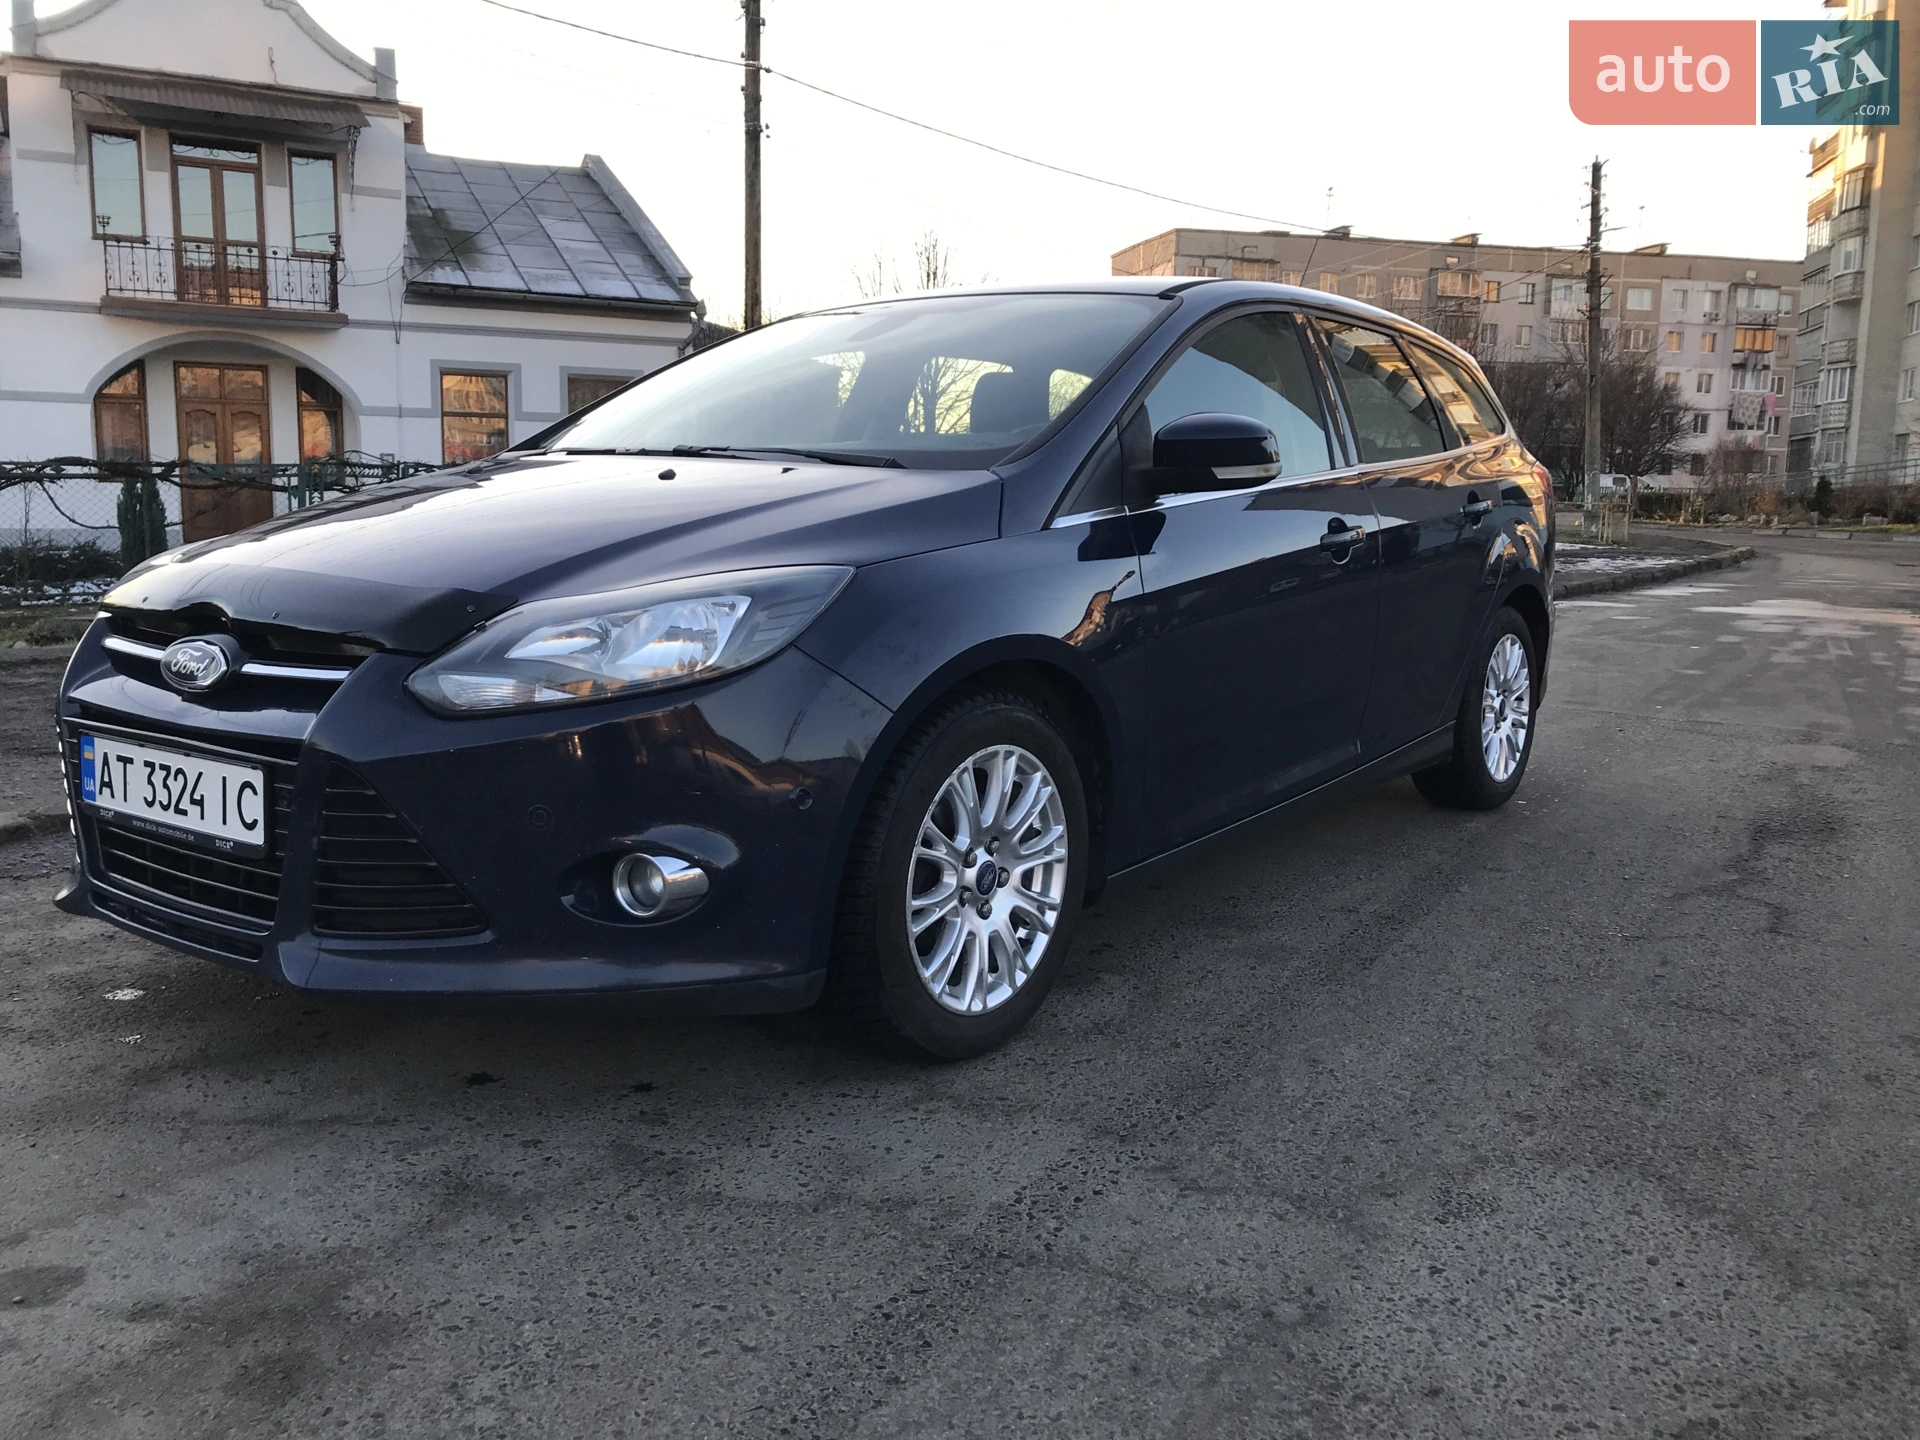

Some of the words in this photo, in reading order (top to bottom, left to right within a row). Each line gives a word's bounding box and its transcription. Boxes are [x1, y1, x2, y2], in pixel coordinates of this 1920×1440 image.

[171, 648, 206, 677] Ford
[84, 777, 95, 792] UA
[98, 751, 134, 803] AT
[143, 760, 205, 821] 3324
[221, 775, 259, 831] IC
